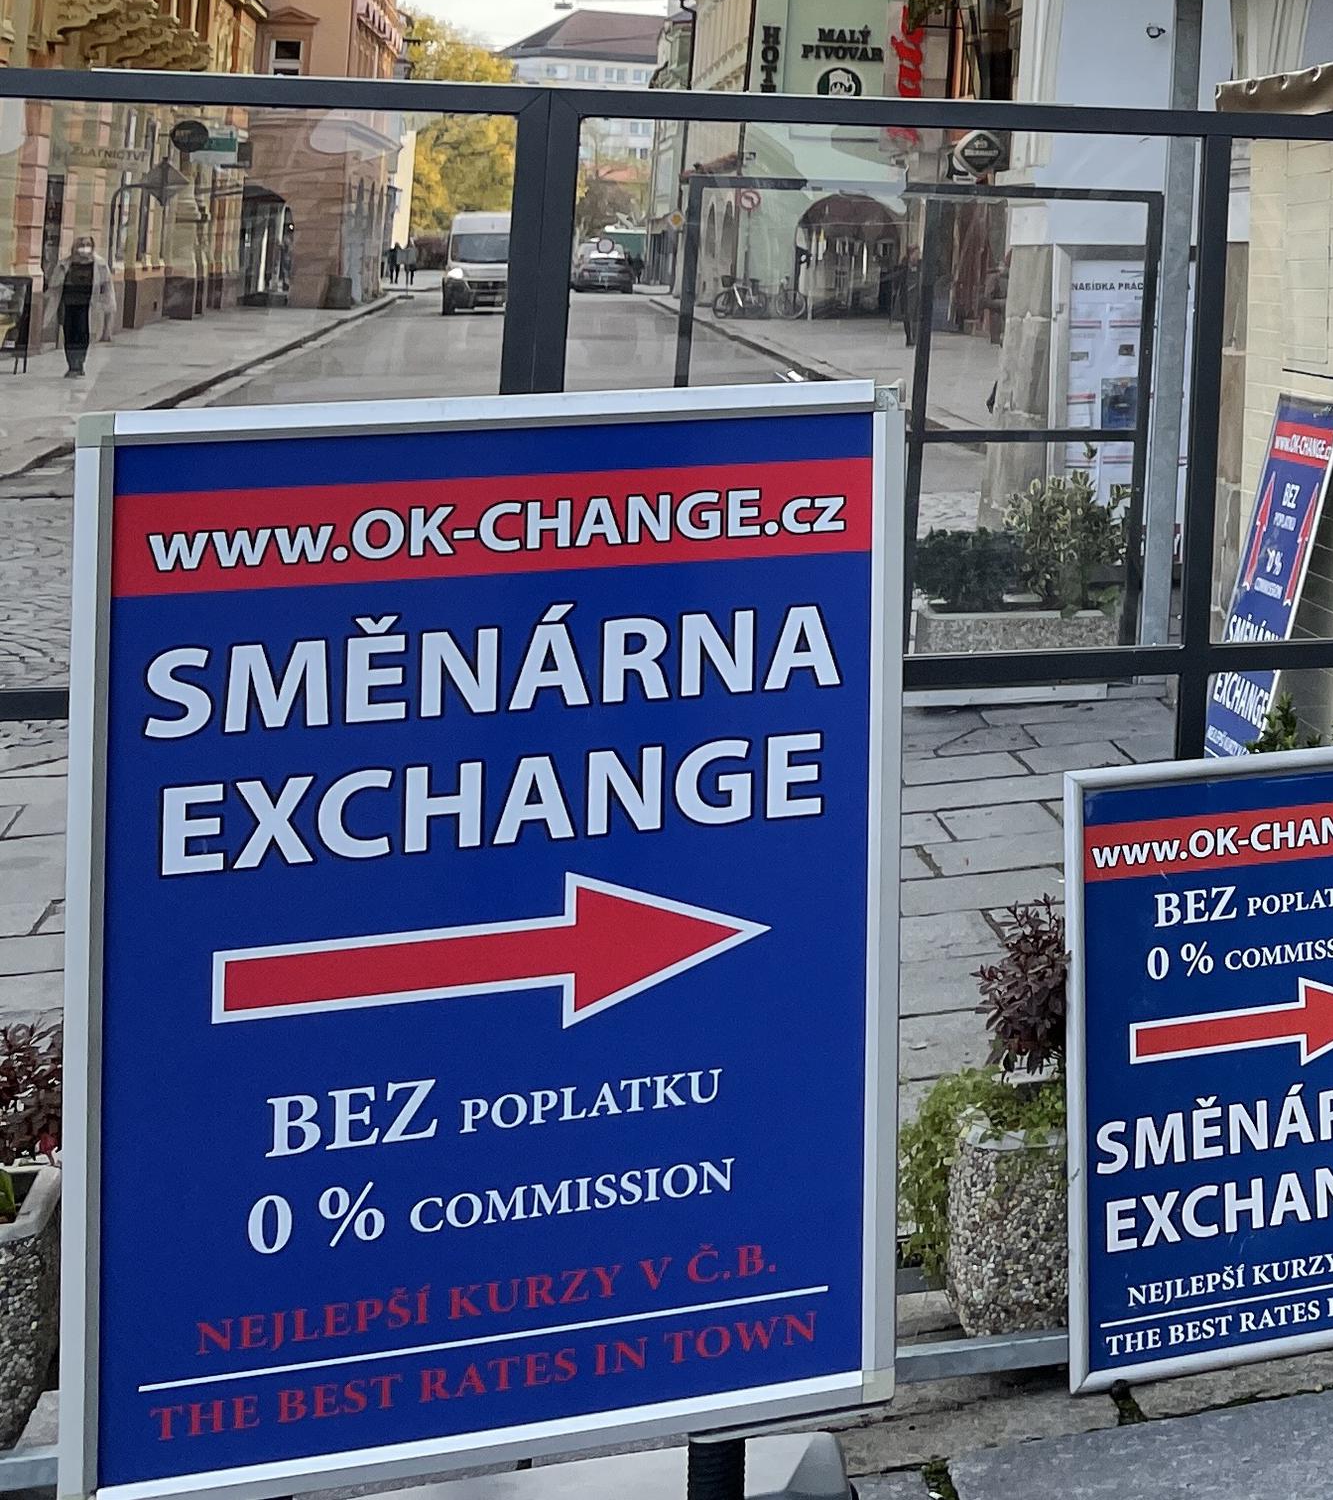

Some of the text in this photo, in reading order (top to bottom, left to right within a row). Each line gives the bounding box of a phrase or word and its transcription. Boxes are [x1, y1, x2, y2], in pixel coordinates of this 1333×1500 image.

[801, 44, 884, 62] PIVOVAR
[818, 24, 871, 44] MALÝ
[1072, 280, 1115, 291] NABÍDKA
[1282, 483, 1300, 509] BEZ
[146, 487, 846, 573] www.OK-CHANGE.cz
[144, 603, 841, 740] SMĚNÁRNA
[1213, 672, 1270, 729] EXCHANGE
[160, 732, 825, 878] EXCHANGE
[1154, 887, 1239, 929] BEZ
[1147, 945, 1168, 980] 0
[1180, 942, 1214, 976] %
[265, 1067, 722, 1159] BEZ POPLATKU
[246, 1156, 735, 1254] 0 % COMMISSION
[196, 1242, 777, 1356] NEJLEPŠÍ KURZY V Č.B.
[1127, 1264, 1244, 1308] NEJLEPŠÍ
[1106, 1325, 1162, 1356] THE
[1168, 1317, 1232, 1348] BEST
[1239, 1303, 1321, 1337] RATES
[150, 1310, 818, 1444] THE BEST RATES IN TOWN
